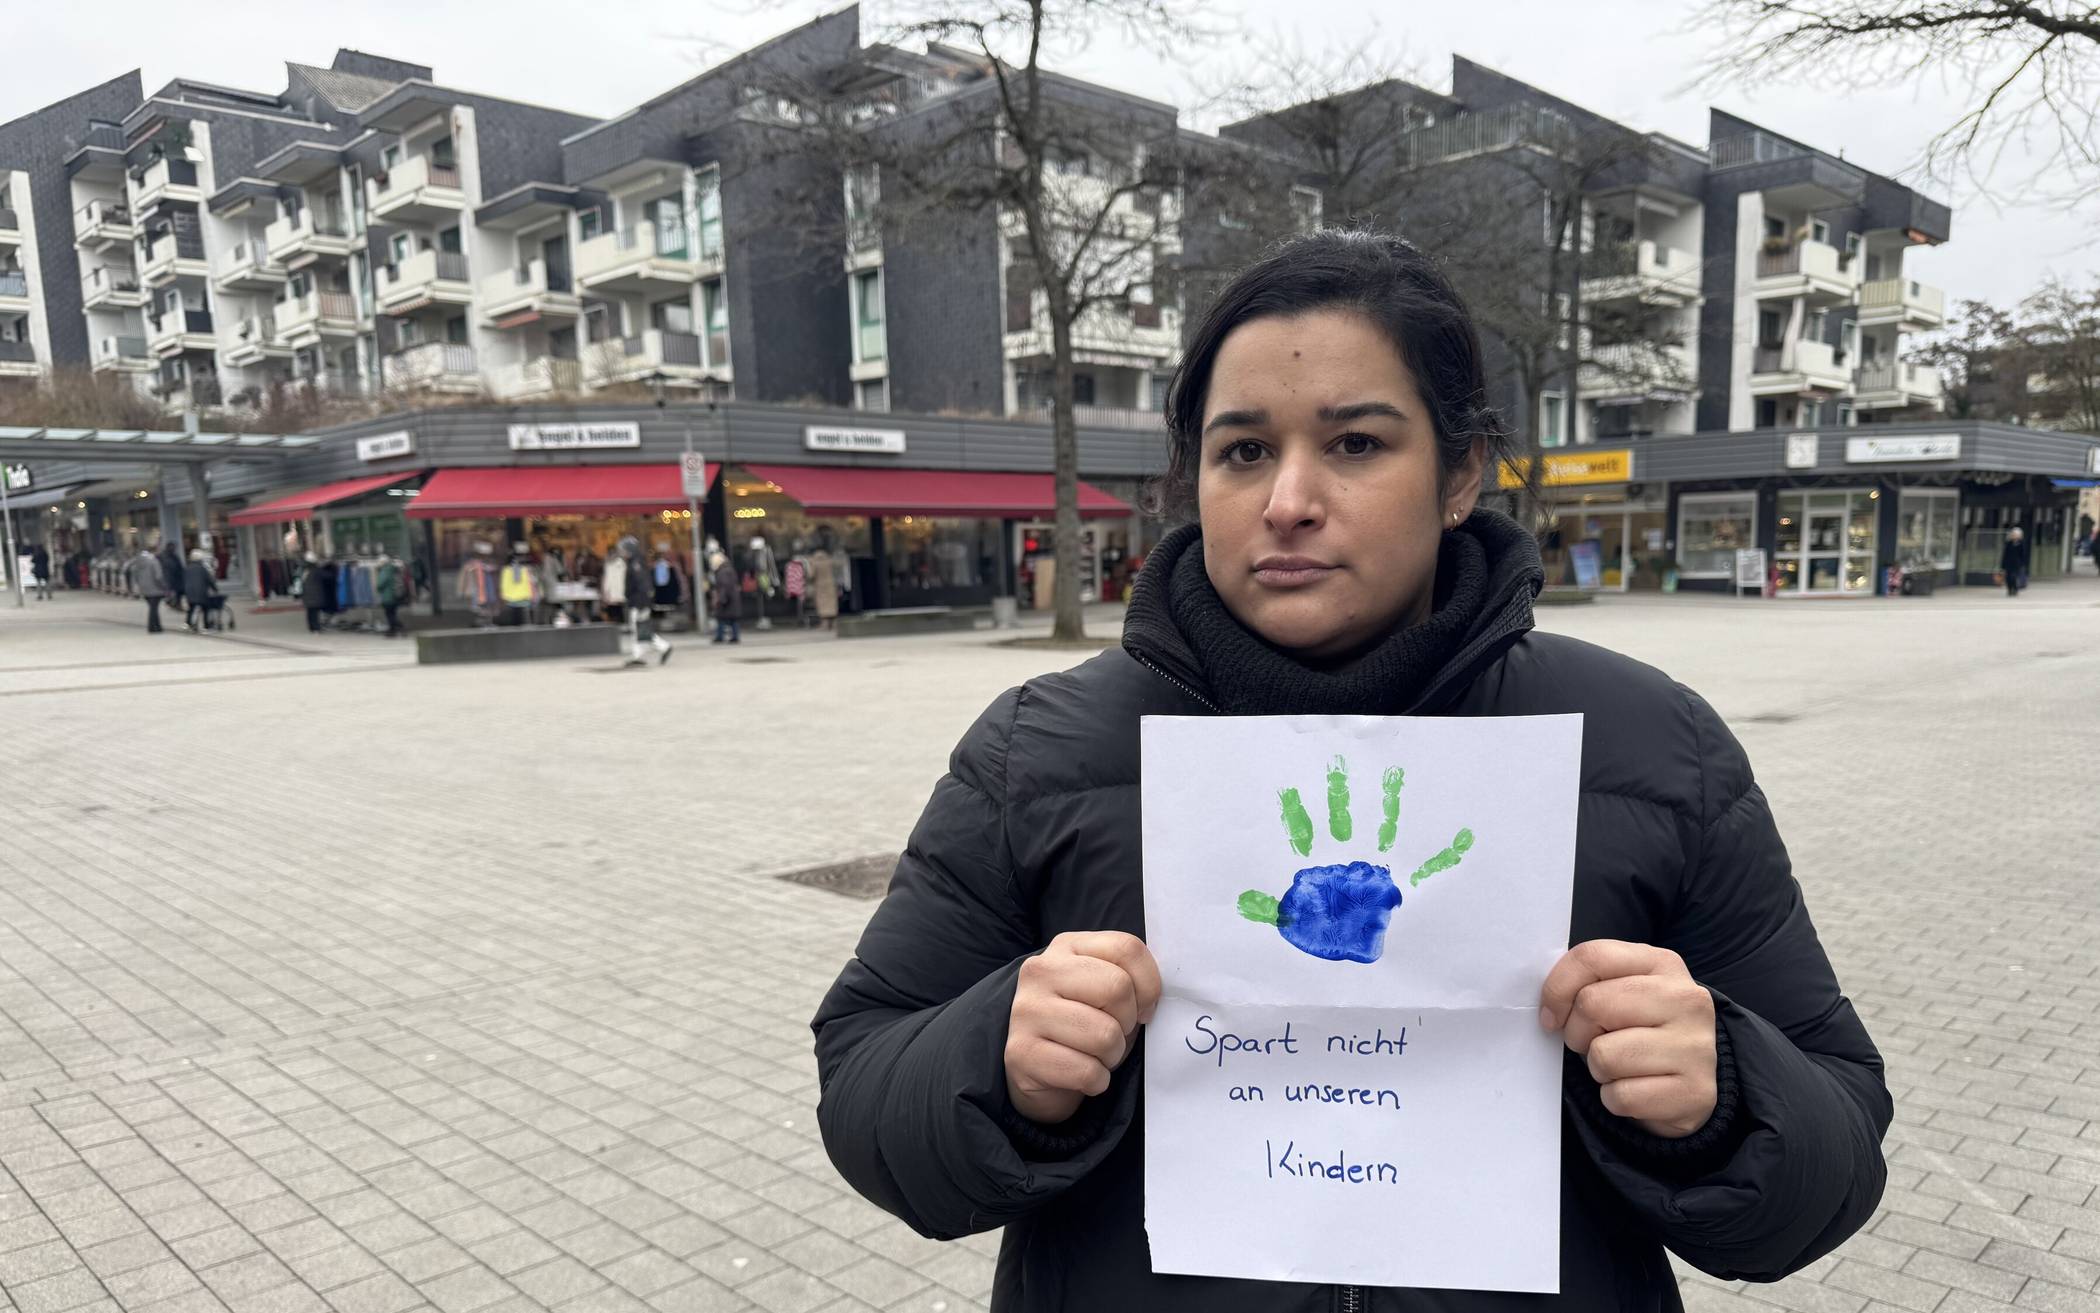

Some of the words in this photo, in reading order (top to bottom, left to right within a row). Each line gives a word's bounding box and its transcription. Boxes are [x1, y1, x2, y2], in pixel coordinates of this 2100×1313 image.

[1185, 1015, 1299, 1067] Spart
[1327, 1026, 1408, 1056] nicht
[1228, 1085, 1264, 1102] an
[1285, 1083, 1401, 1110] unseren
[1266, 1139, 1398, 1184] Kindern
